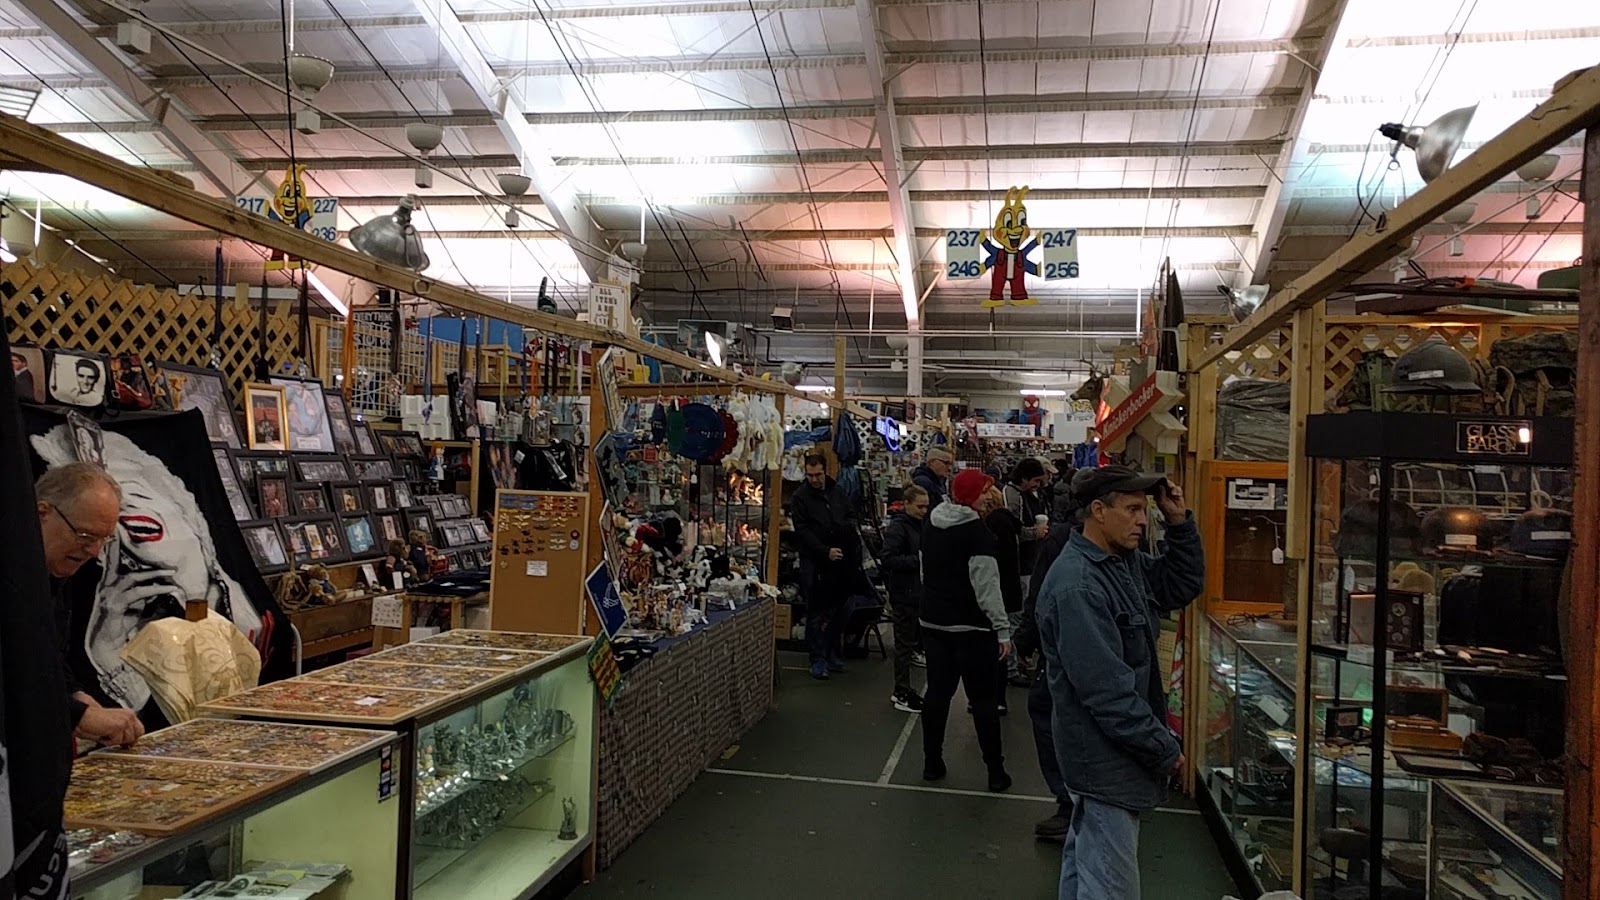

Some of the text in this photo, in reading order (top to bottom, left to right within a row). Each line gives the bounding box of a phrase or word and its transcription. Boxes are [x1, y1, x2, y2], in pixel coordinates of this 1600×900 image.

[237, 197, 265, 215] 217
[314, 199, 337, 214] 227
[312, 226, 337, 241] 236
[947, 230, 980, 247] 237
[1042, 229, 1076, 248] 247
[948, 260, 981, 277] 246
[1045, 261, 1079, 279] 256
[1466, 424, 1517, 440] GLASS
